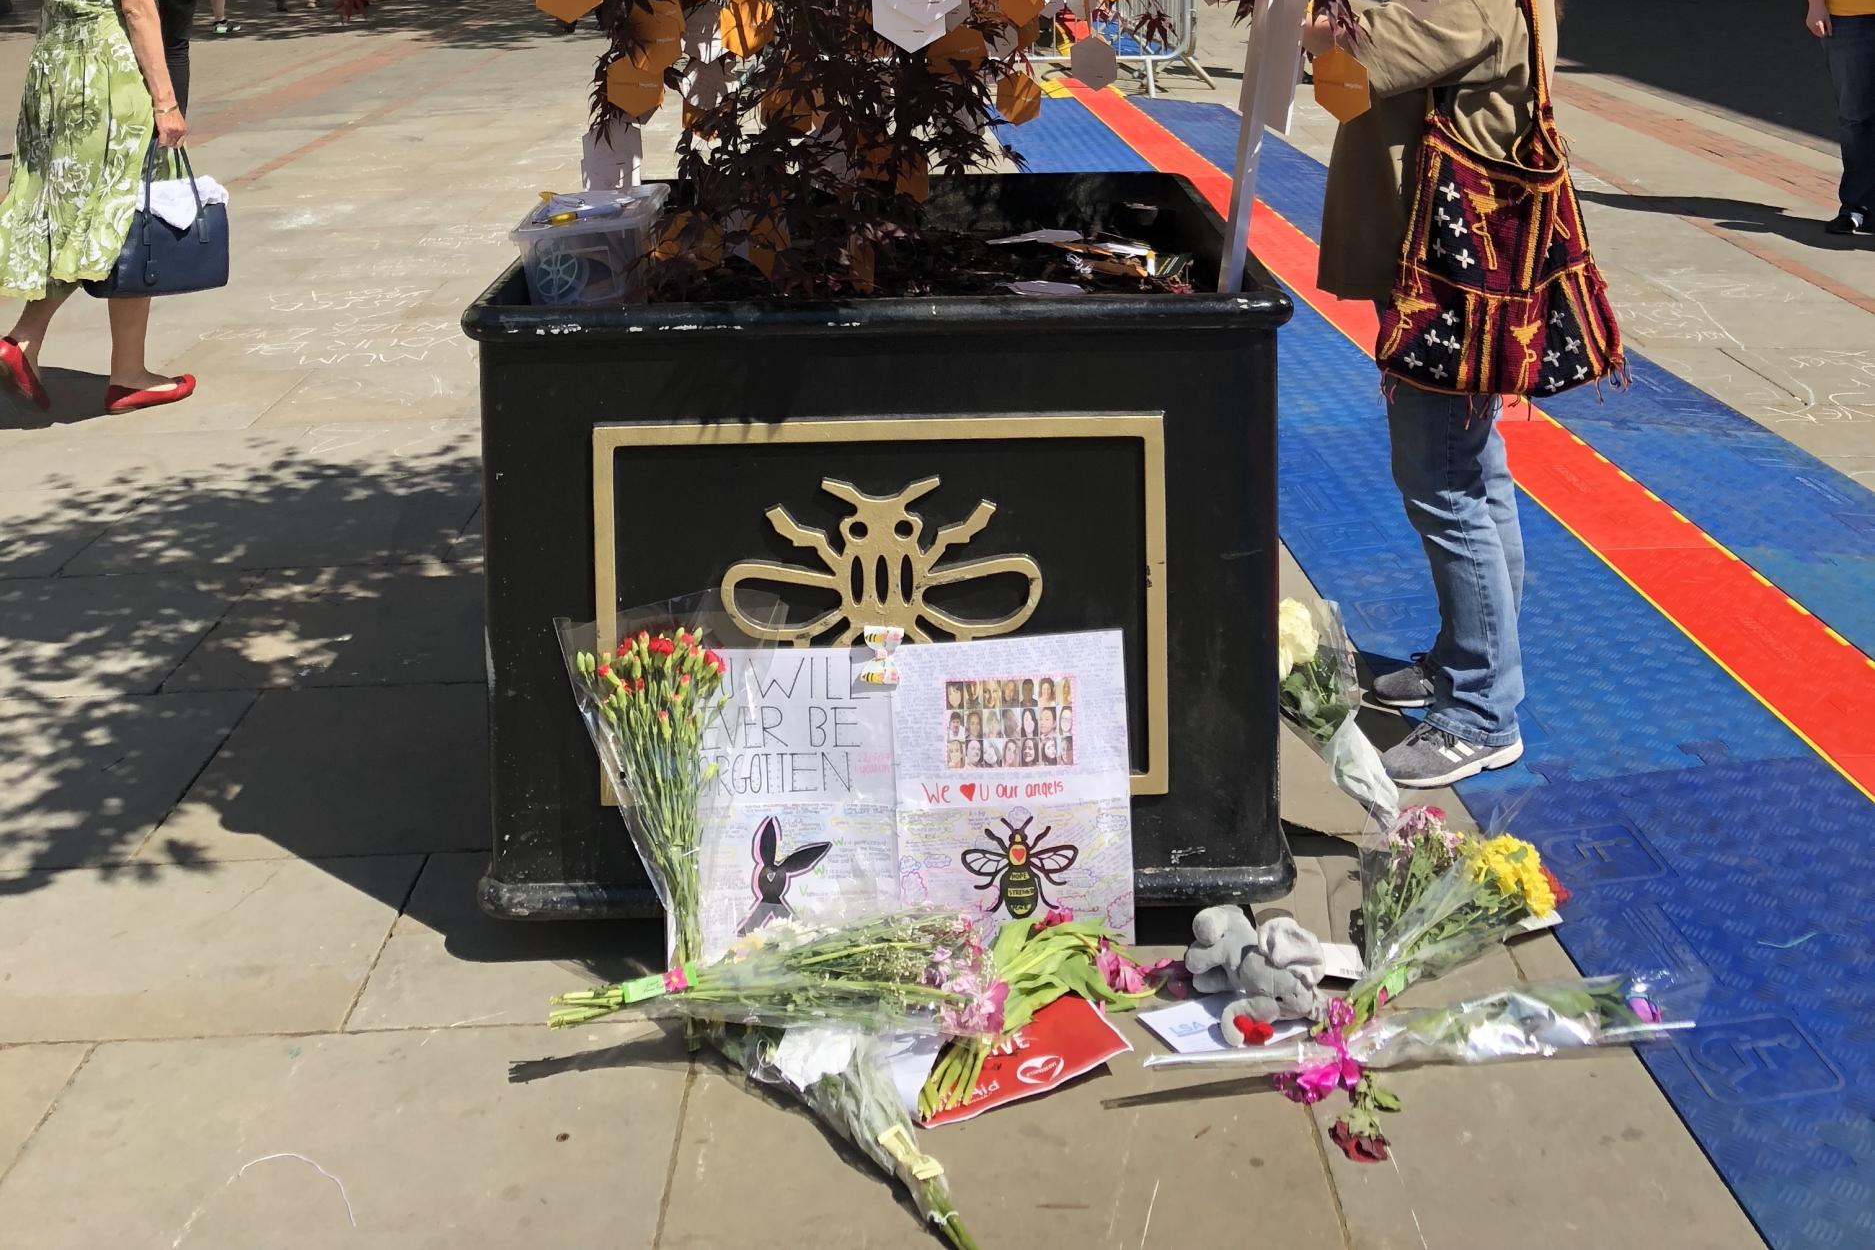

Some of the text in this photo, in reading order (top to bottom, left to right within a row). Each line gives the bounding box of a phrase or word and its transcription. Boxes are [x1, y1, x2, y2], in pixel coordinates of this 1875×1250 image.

[748, 656, 872, 700] WILL
[699, 706, 789, 751] EVER
[808, 706, 864, 749] BE
[698, 751, 854, 798] ORGOTTEN
[921, 782, 951, 805] We
[979, 784, 990, 802] U
[1025, 780, 1065, 801] angels
